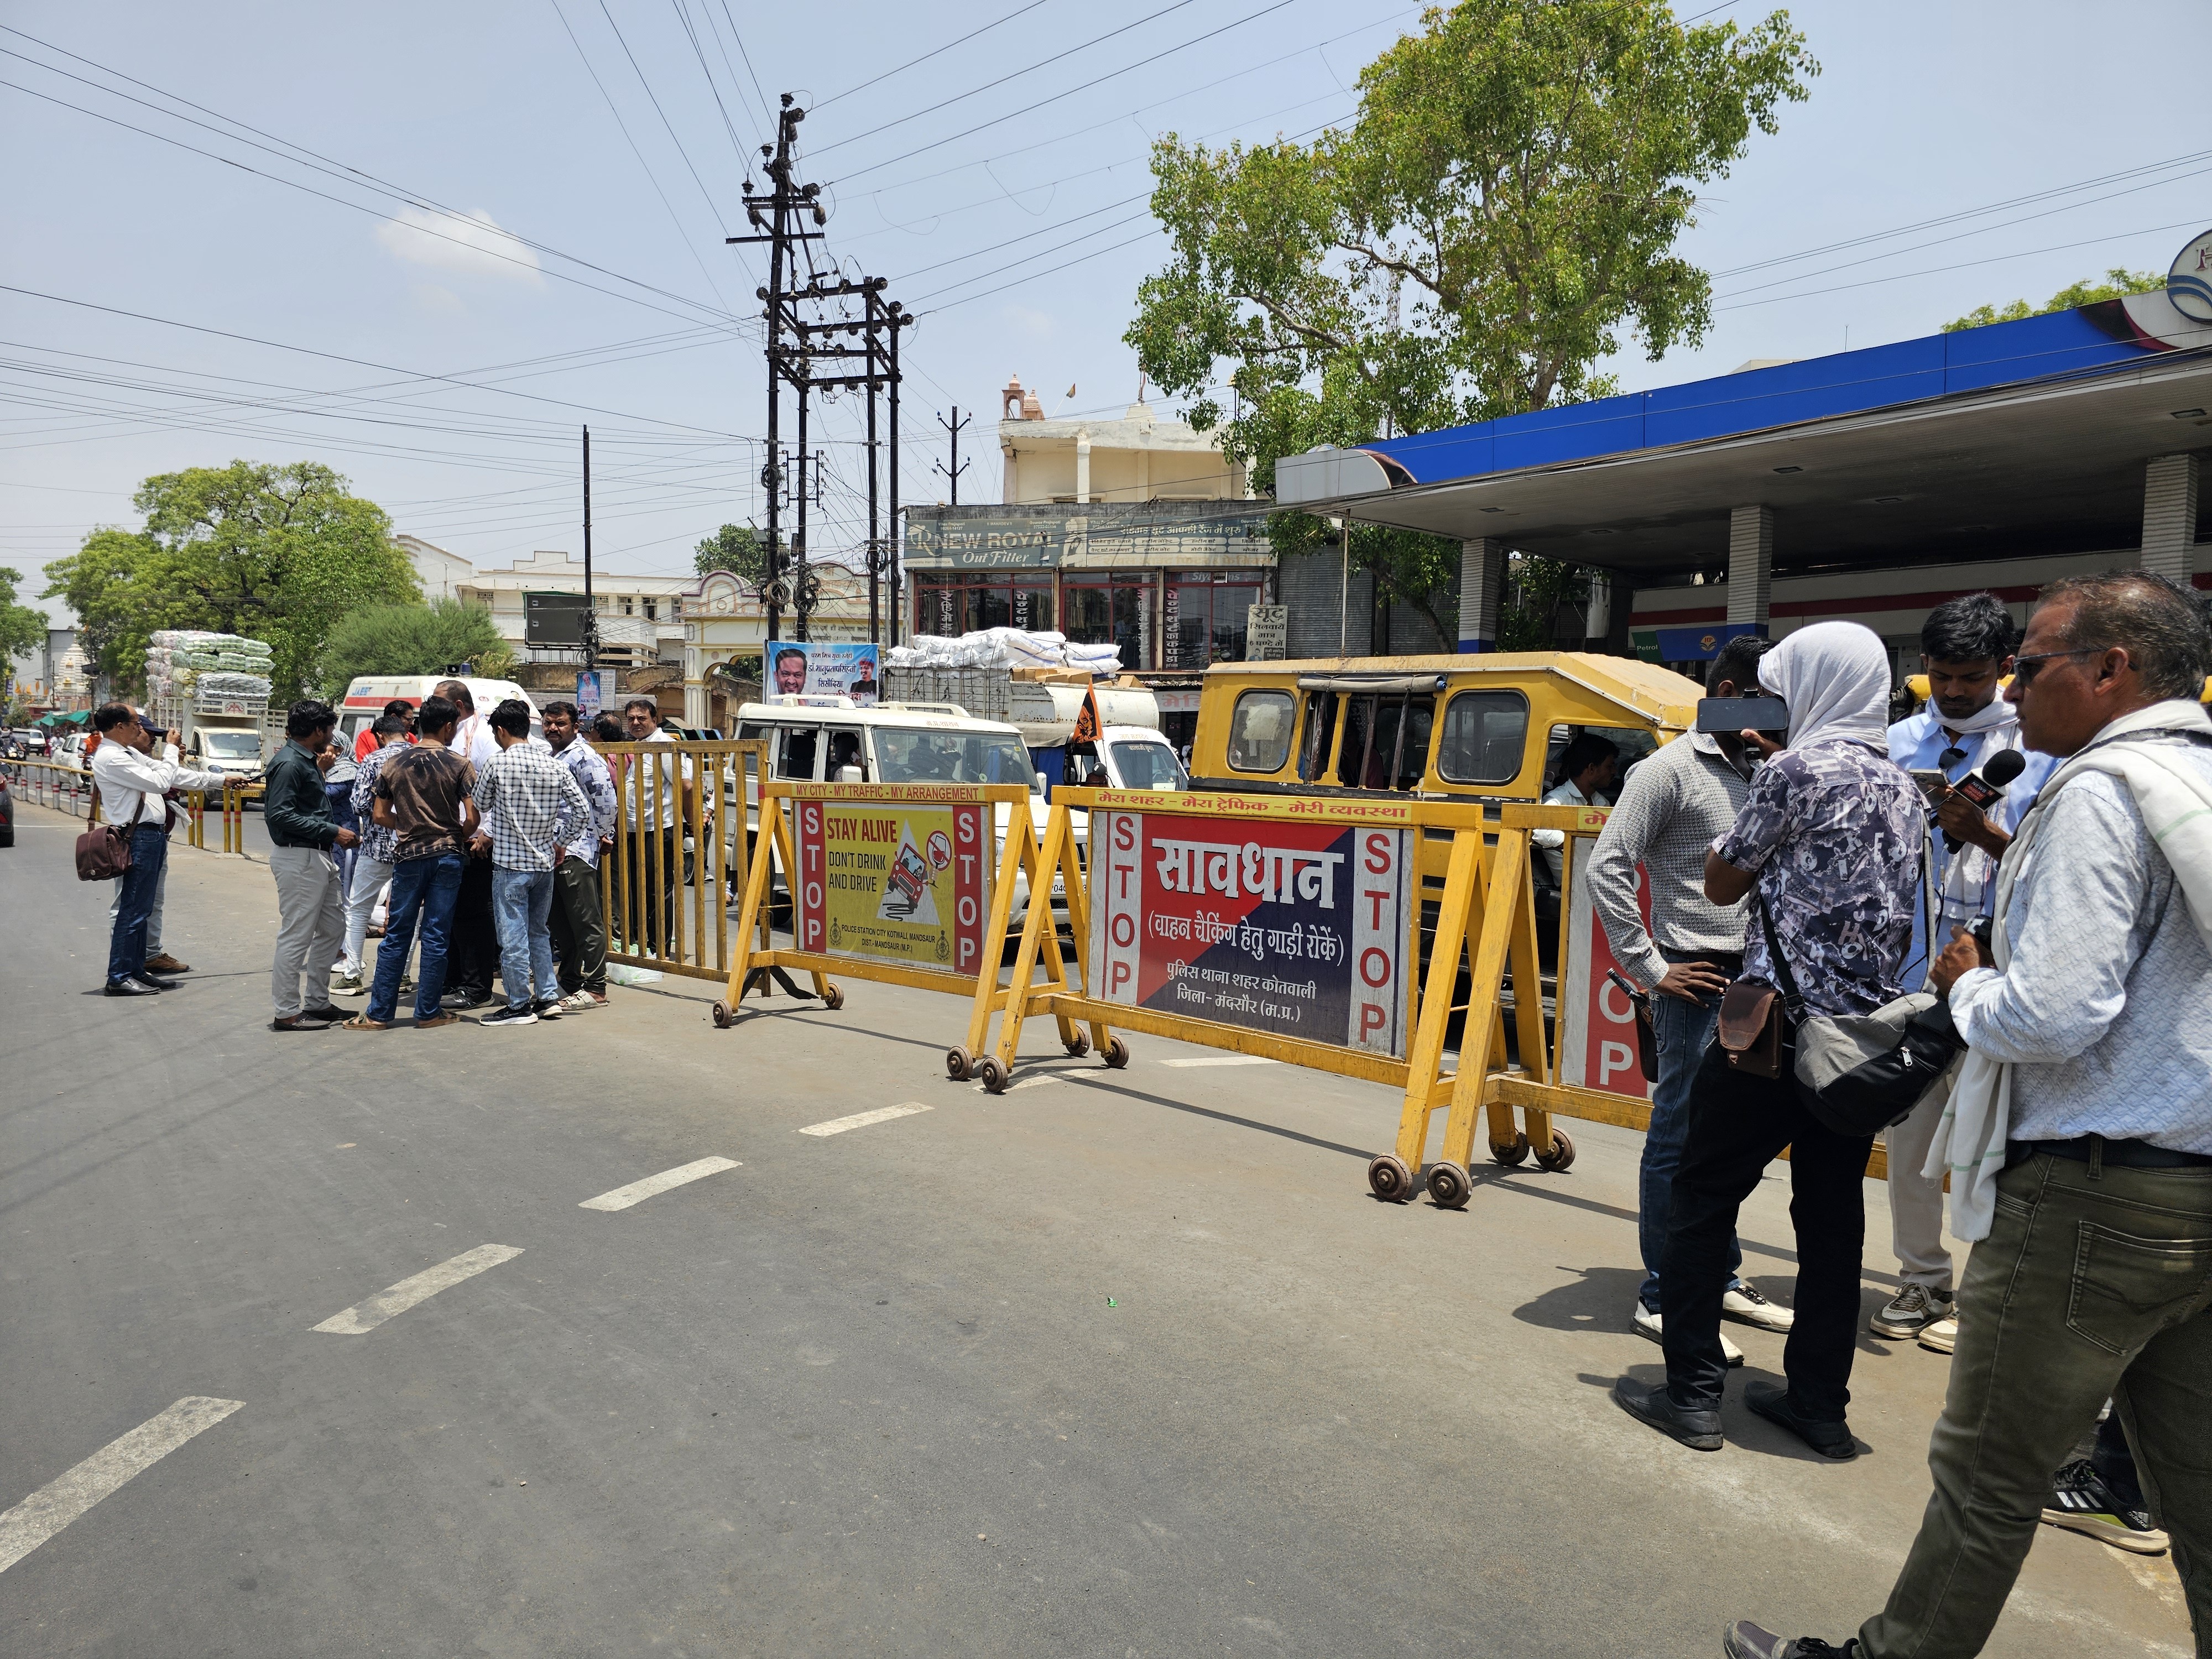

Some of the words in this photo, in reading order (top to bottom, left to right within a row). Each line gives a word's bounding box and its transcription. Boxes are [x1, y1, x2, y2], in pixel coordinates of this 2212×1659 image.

[935, 533, 981, 549] NEW
[988, 532, 1058, 549] ROYAL
[1214, 524, 1223, 534] में
[963, 551, 988, 563] Out
[797, 785, 807, 795] MY
[810, 785, 826, 796] CITY
[834, 786, 845, 796] MY
[848, 786, 884, 797] TRAFFIC
[891, 786, 903, 798] MY
[906, 787, 978, 800] ARRANGEMENT
[1971, 781, 1987, 793] NEWS
[1098, 791, 1126, 803] मेरा
[1129, 796, 1165, 805] शहर
[1182, 795, 1213, 808] मेरा
[1288, 800, 1324, 815] मेरी
[1328, 805, 1407, 818] व्यवस्था
[827, 817, 857, 841] STAY
[862, 819, 898, 843] ALIVE
[829, 851, 855, 868] DON'T
[858, 853, 886, 871] DRINK
[805, 807, 823, 946] STOP
[829, 873, 847, 890] AND
[850, 875, 877, 892] DRIVE
[1152, 838, 1345, 910] सावधान
[958, 812, 977, 967] STOP
[1111, 816, 1135, 995] STOP
[842, 925, 857, 933] POLICE
[857, 926, 876, 936] STATION
[877, 928, 886, 936] CITY
[909, 932, 936, 943] MANDSAUR
[1149, 910, 1191, 940] (वाहन
[1194, 910, 1238, 948] चैकिंग
[1241, 915, 1264, 961] हेतु
[1269, 922, 1303, 960] गाड़ी
[1307, 924, 1344, 967] रोकें)
[1359, 833, 1391, 1044] STOP
[875, 940, 899, 951] MANDSAUR
[900, 943, 912, 953] (M.P.)
[1167, 961, 1198, 981] पुलिस
[1201, 967, 1230, 985] थाना
[1232, 973, 1259, 989] शहर
[1262, 975, 1317, 1000] कोतवाली
[1215, 991, 1258, 1014] मंदसौर
